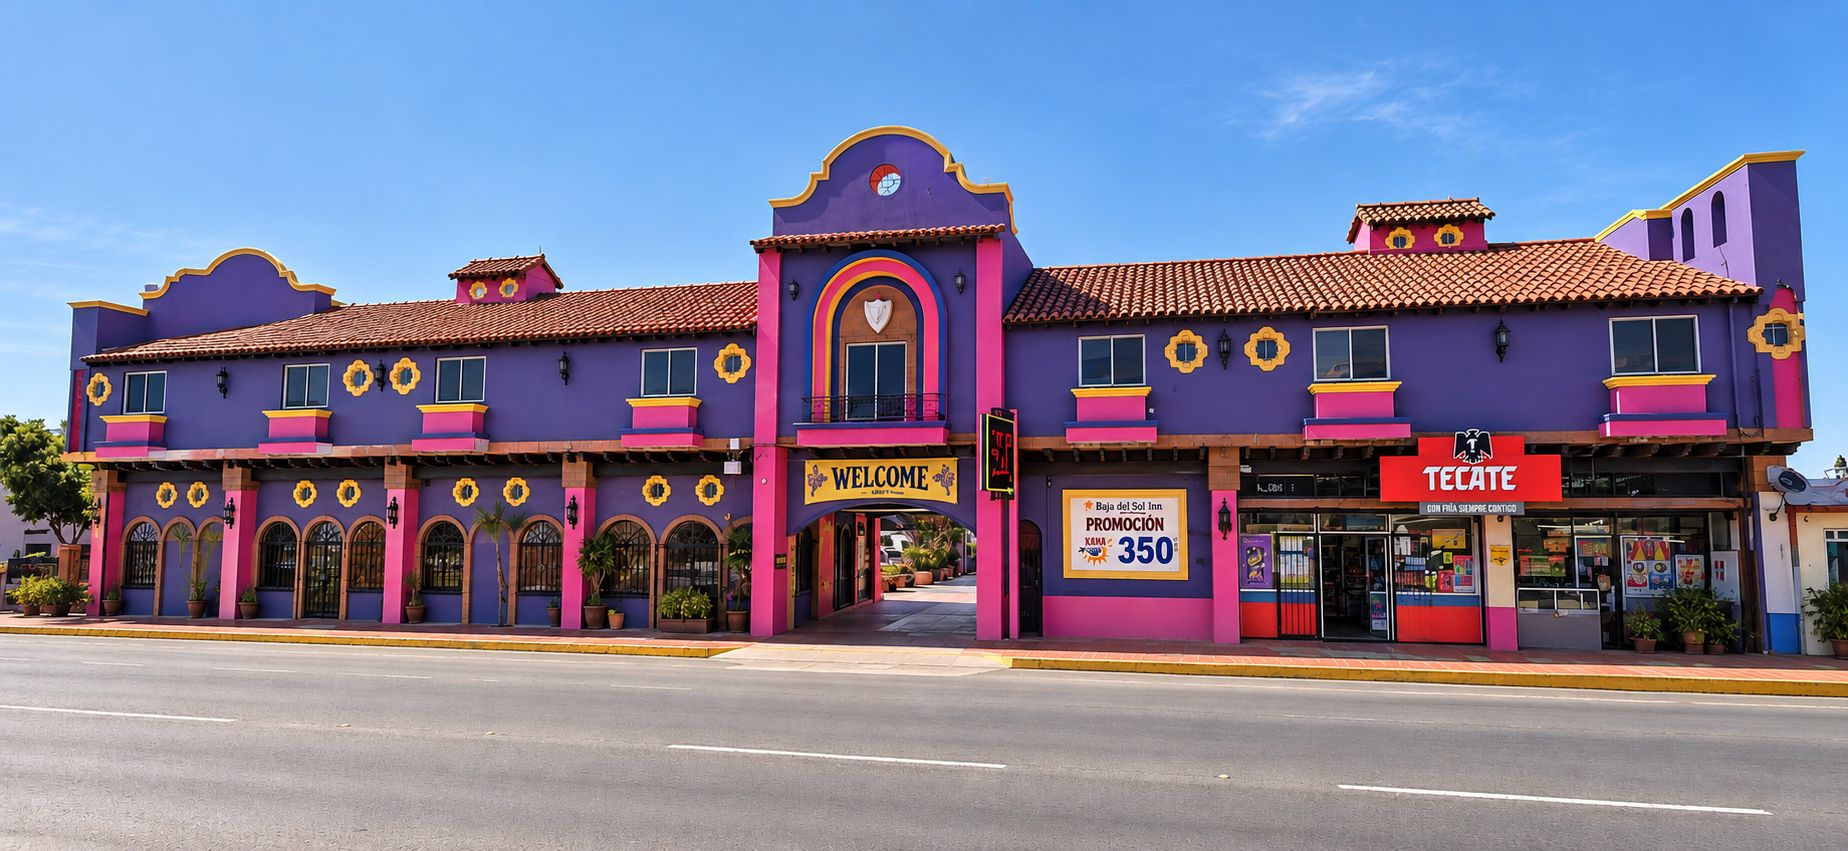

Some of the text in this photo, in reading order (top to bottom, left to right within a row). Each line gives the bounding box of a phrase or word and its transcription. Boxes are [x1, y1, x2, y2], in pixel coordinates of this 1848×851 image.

[831, 465, 929, 491] WELCOME
[1422, 465, 1518, 491] TECATE
[1096, 501, 1163, 513] Baja del Sol Inn
[1086, 514, 1164, 532] PROMOCIÓN
[1118, 536, 1174, 565] 350
